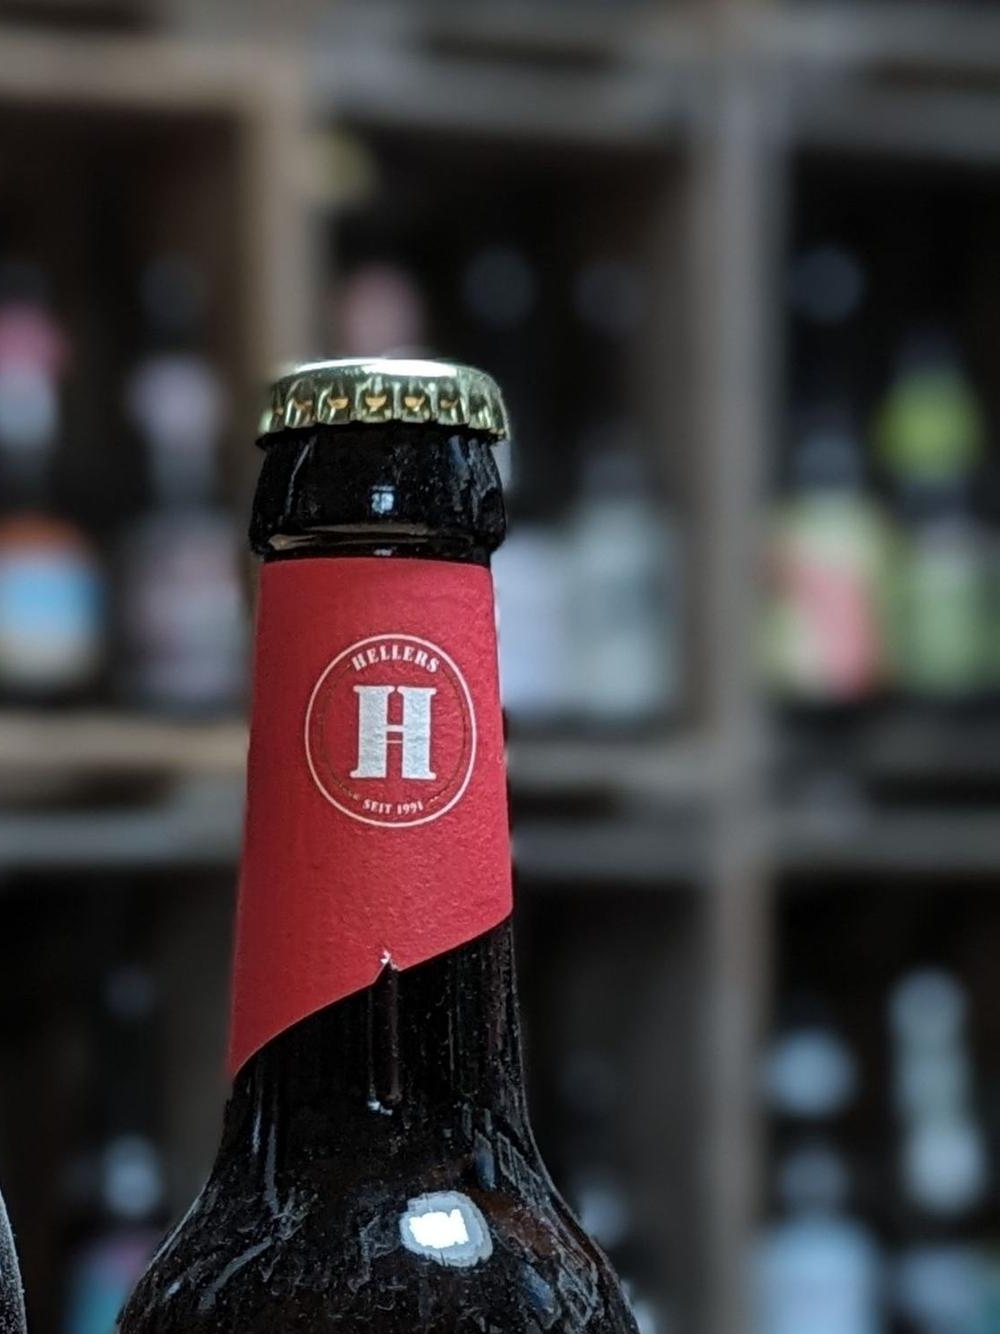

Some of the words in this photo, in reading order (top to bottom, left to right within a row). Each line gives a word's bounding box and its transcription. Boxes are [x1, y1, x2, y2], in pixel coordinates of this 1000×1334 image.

[351, 644, 441, 673] HELLERS
[350, 685, 437, 780] H
[362, 799, 392, 814] SEIT
[397, 801, 424, 815] 1991
